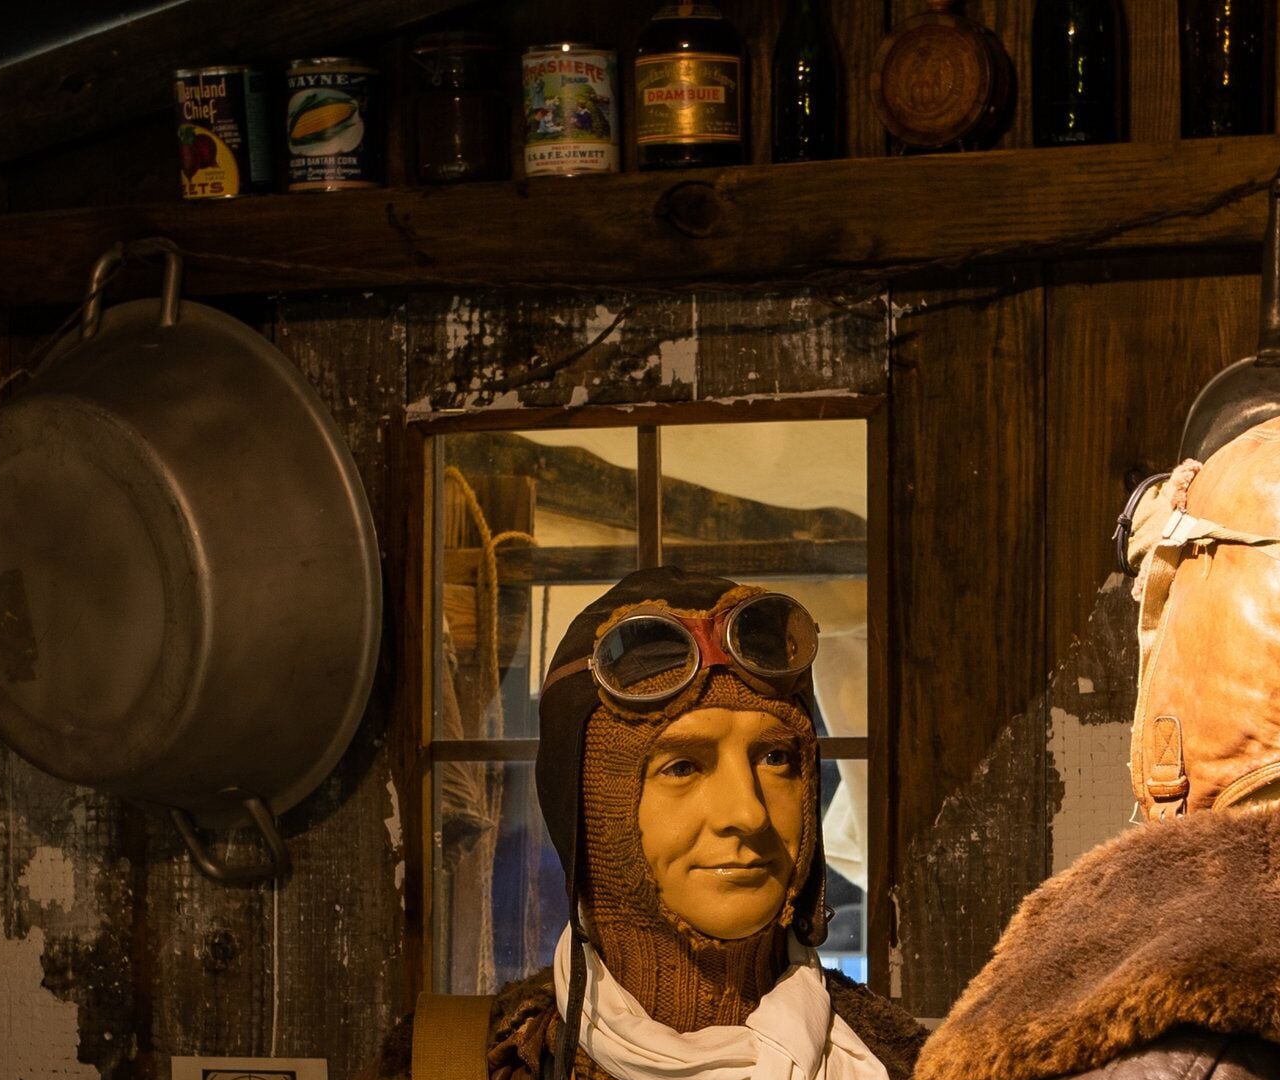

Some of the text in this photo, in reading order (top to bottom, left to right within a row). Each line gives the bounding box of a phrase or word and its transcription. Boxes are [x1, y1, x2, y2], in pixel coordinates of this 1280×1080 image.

[647, 88, 720, 103] DRAMBUIE
[183, 99, 218, 124] Chief
[565, 150, 605, 160] JEWETT
